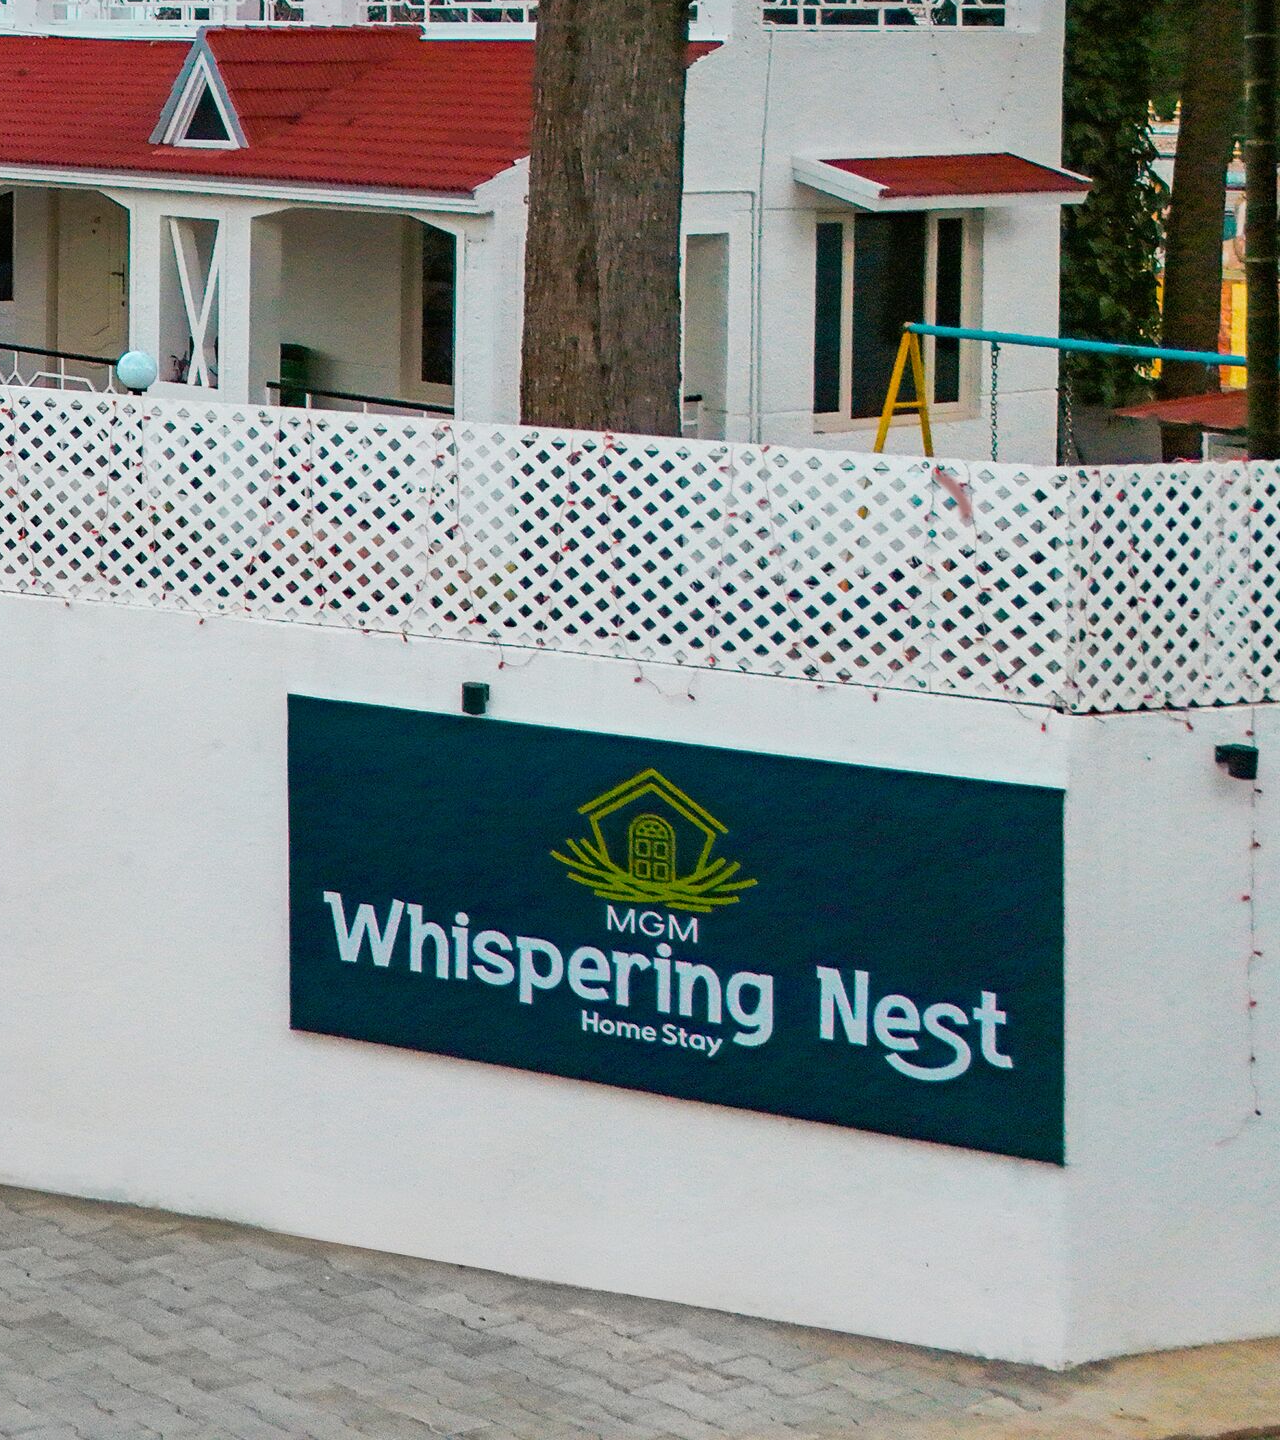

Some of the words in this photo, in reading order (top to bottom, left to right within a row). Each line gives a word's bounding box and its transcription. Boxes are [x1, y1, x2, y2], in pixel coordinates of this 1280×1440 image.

[606, 904, 699, 944] MGM
[323, 890, 775, 1047] Whispering
[816, 965, 1014, 1082] Nest
[580, 1008, 657, 1043] Home
[662, 1023, 724, 1058] Stay
